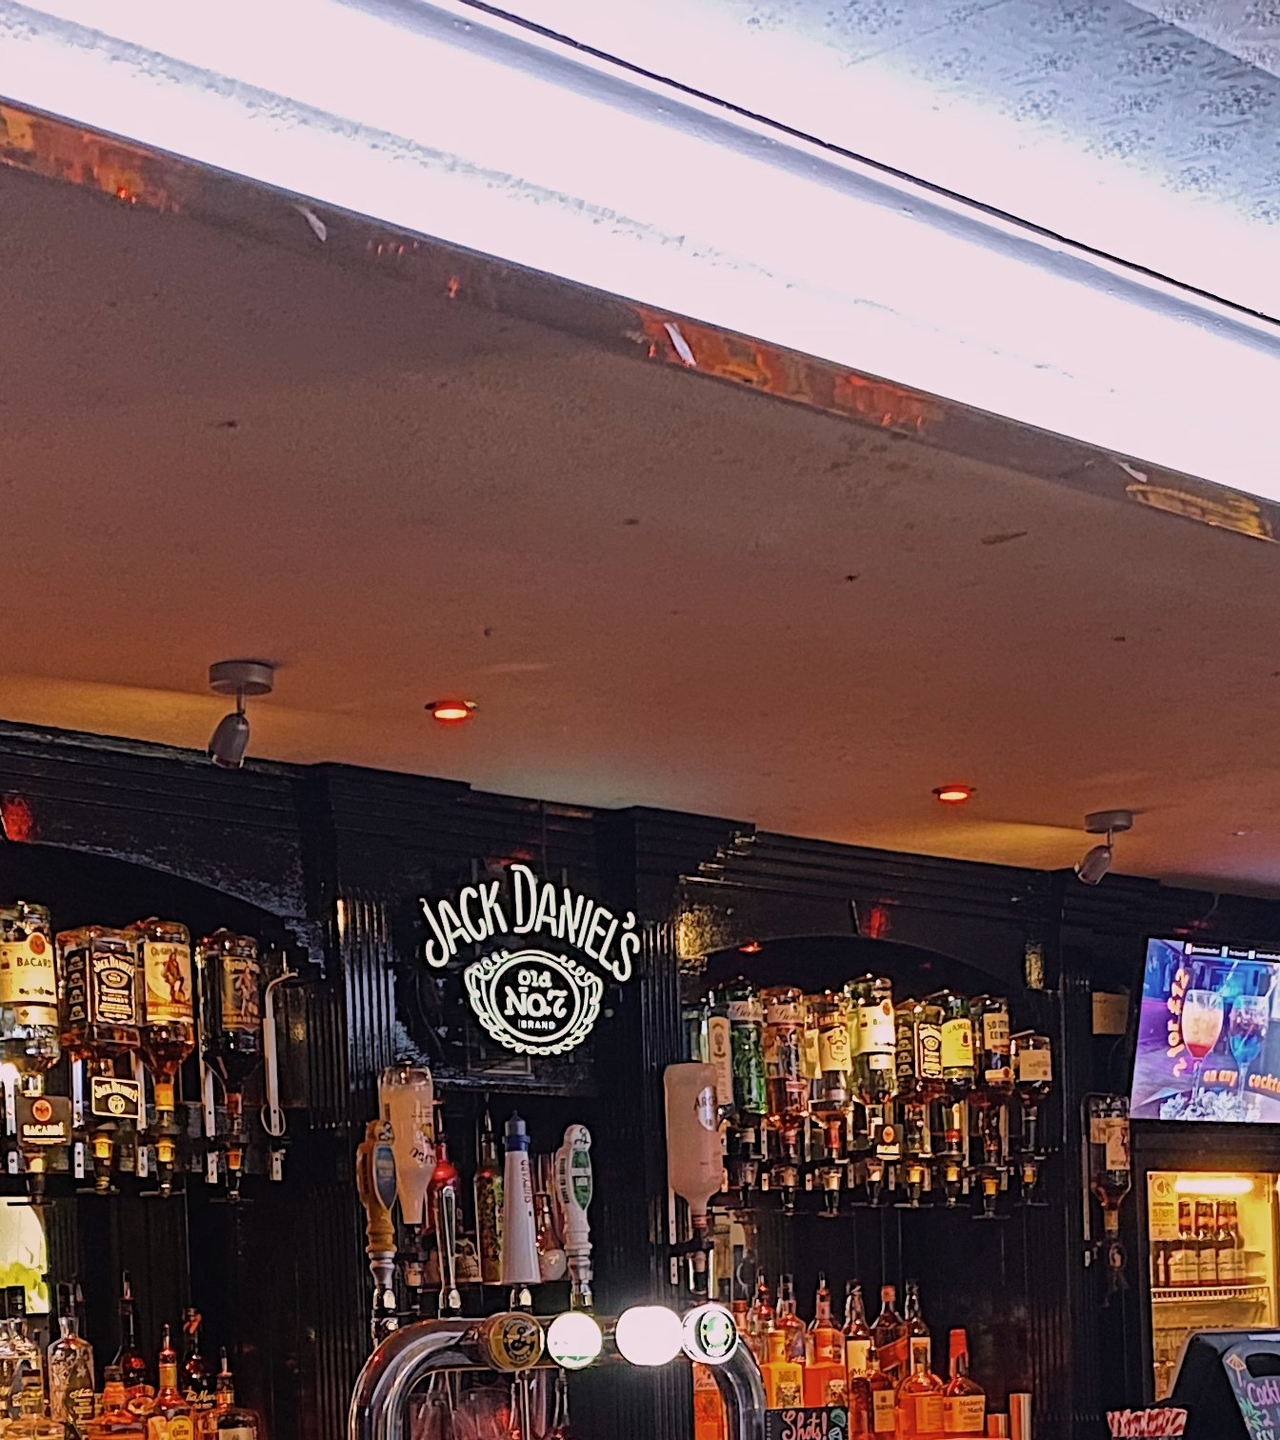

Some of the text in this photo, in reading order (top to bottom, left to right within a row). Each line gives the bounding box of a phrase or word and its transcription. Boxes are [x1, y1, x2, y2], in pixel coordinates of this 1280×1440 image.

[419, 863, 641, 982] JACK DANIEL'S
[518, 969, 553, 988] Old
[520, 1019, 556, 1030] BRAND
